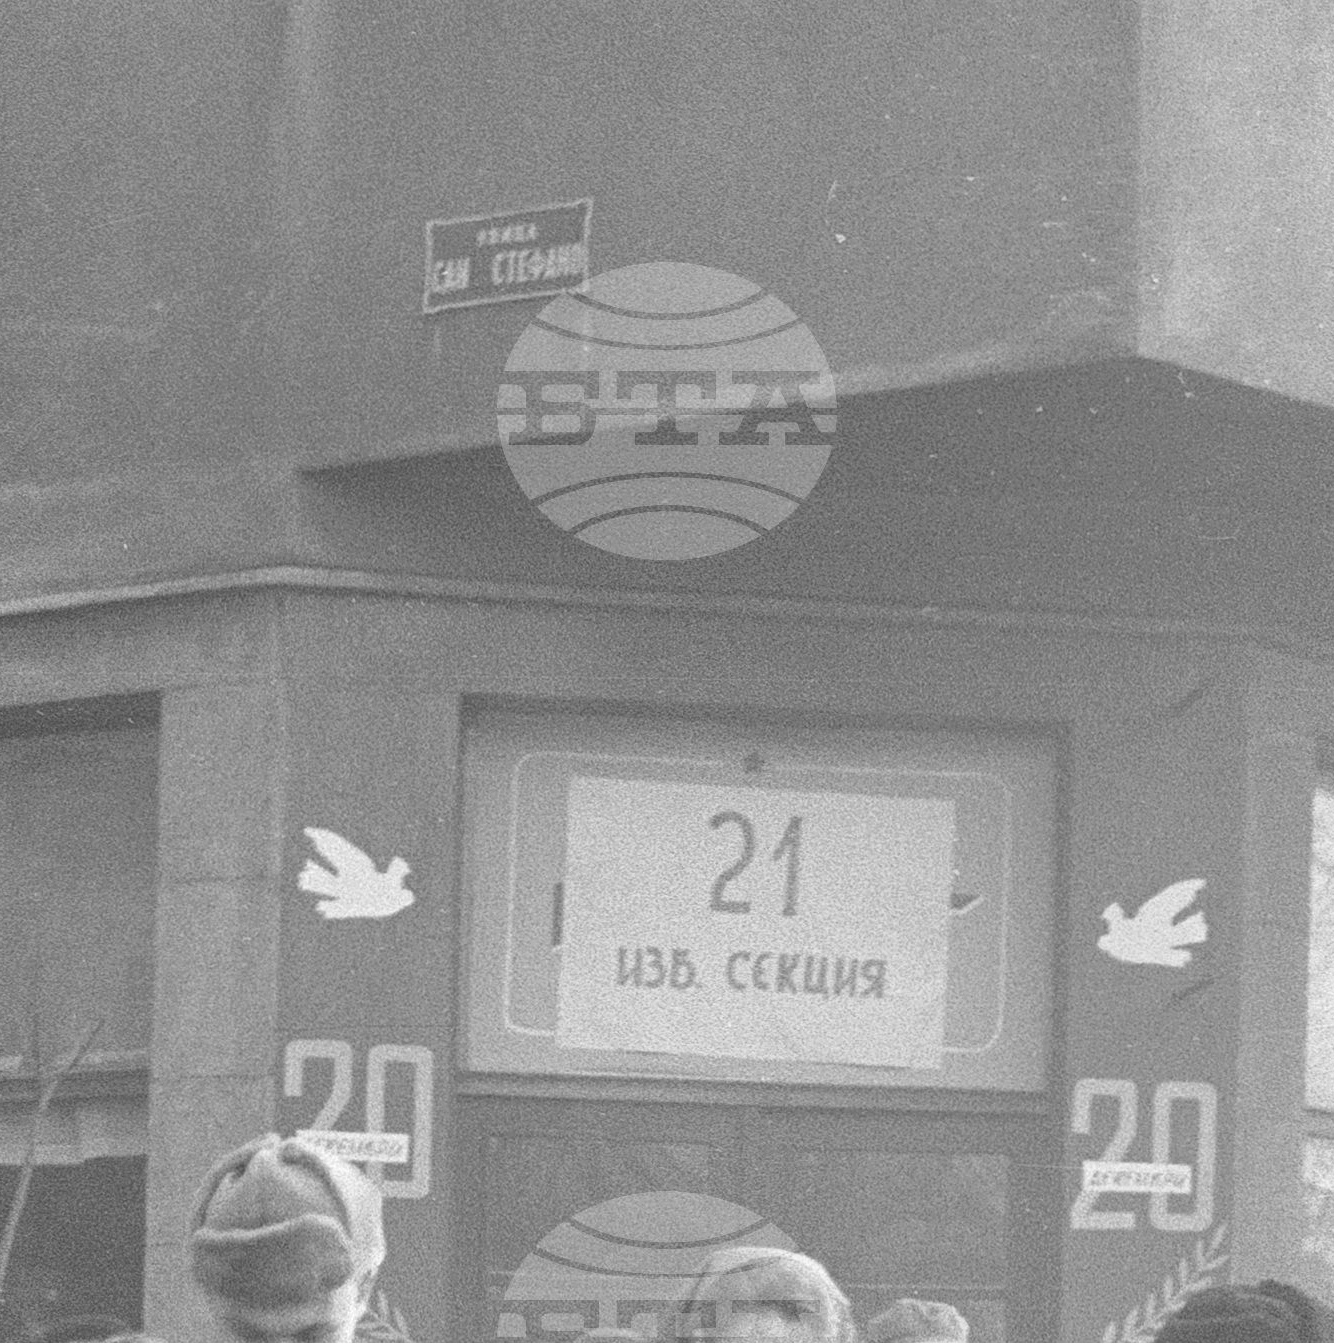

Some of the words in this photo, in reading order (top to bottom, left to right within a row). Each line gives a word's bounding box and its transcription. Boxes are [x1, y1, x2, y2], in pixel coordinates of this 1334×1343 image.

[708, 811, 803, 916] 21
[616, 946, 703, 990] ИЗБ.
[726, 949, 888, 999] СЕКЦИЯ
[284, 1038, 434, 1199] 20
[1070, 1077, 1216, 1231] 20
